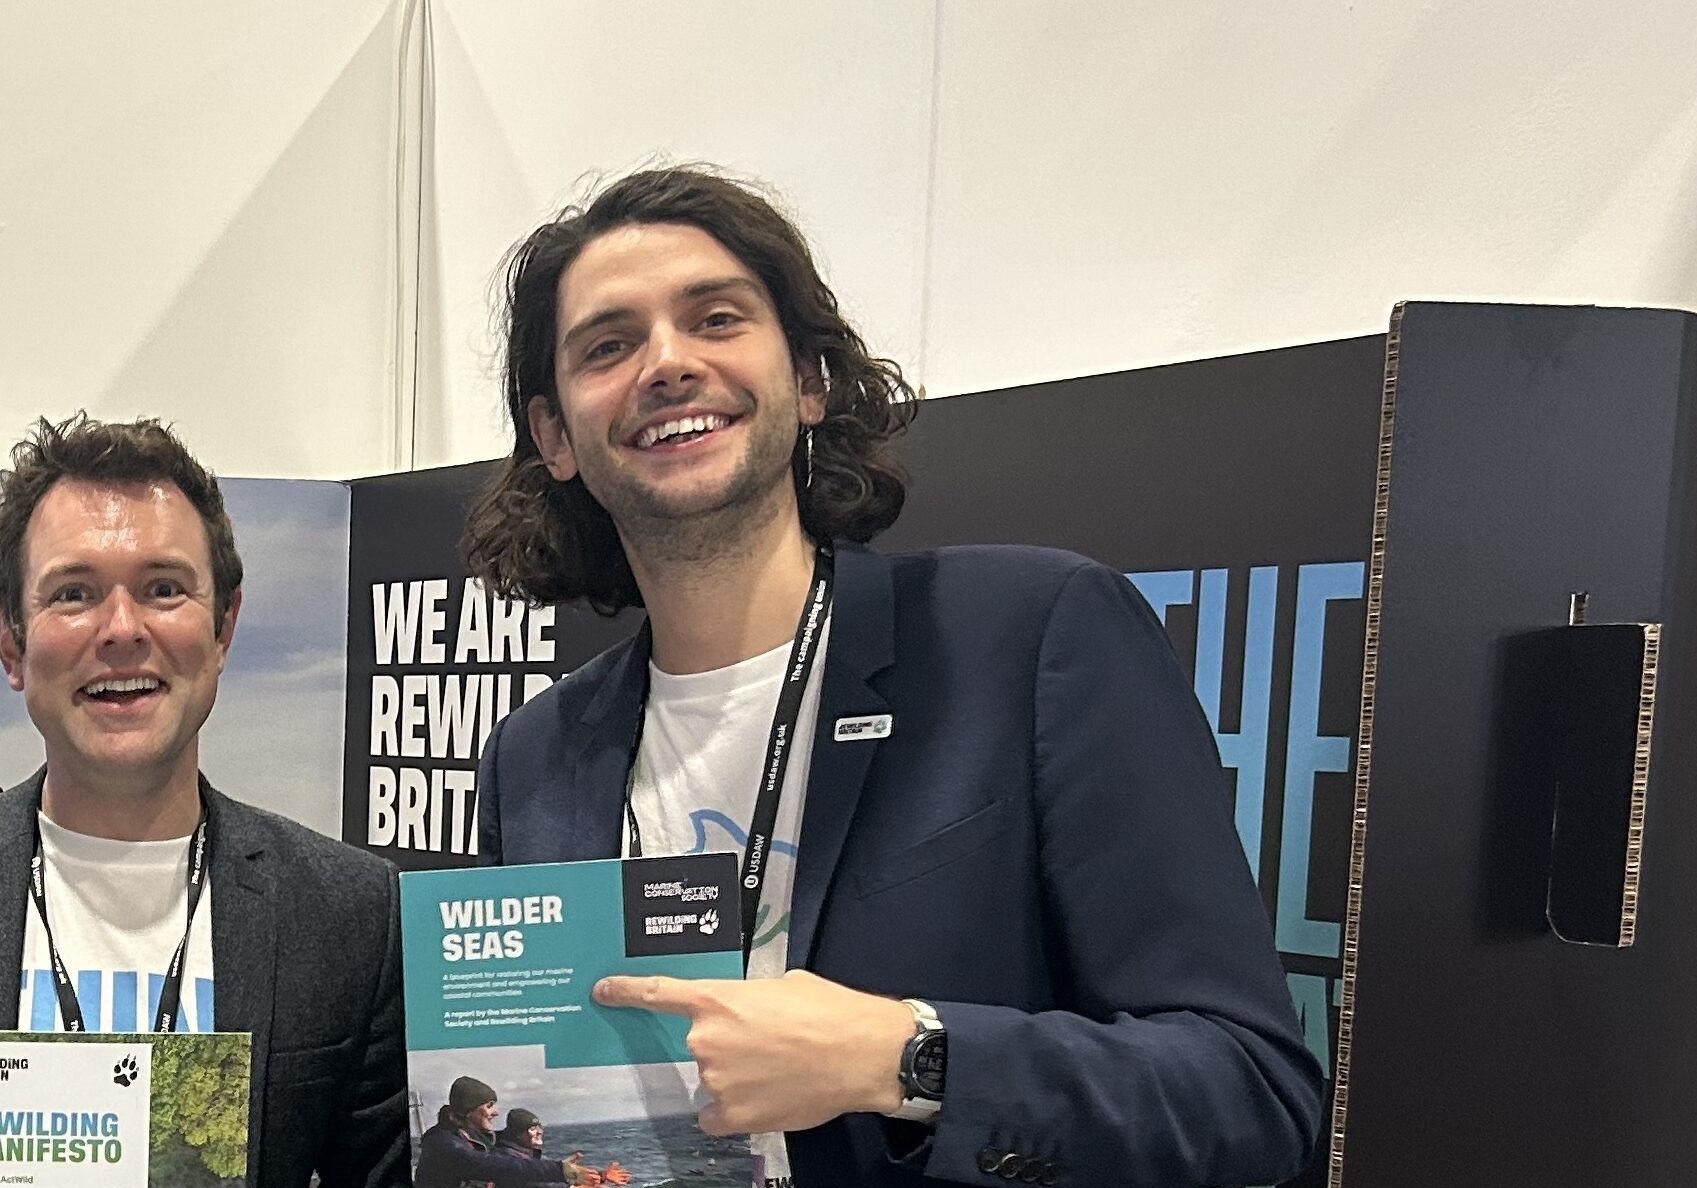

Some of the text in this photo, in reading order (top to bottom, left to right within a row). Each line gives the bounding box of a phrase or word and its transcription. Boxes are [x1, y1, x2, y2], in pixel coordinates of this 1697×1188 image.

[372, 577, 556, 664] WE ARE
[790, 663, 804, 682] The
[767, 724, 788, 792] usdaw.org.uk
[749, 834, 765, 873] USDAW
[439, 895, 564, 929] WILDER
[442, 930, 525, 962] SEAS
